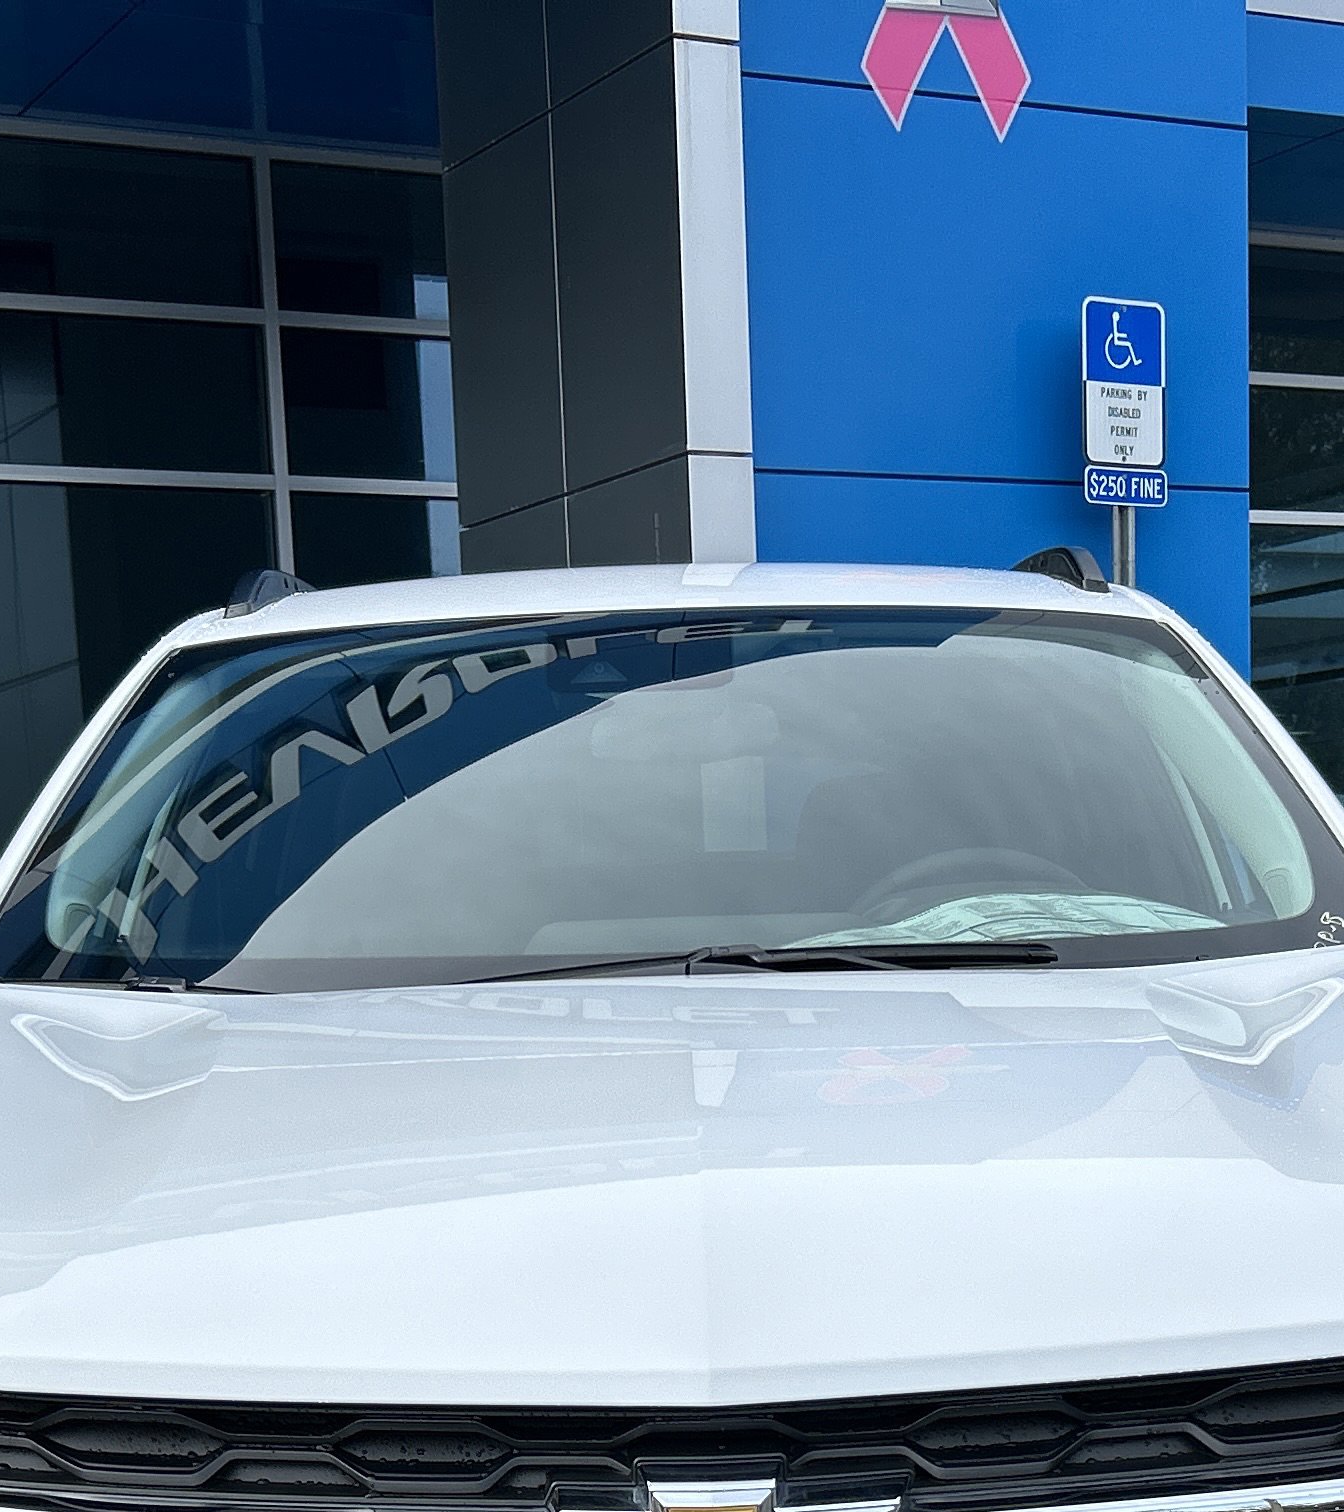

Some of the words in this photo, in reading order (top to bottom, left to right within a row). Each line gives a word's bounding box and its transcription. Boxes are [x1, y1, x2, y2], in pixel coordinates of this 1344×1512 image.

[1100, 386, 1132, 400] PARKING
[1137, 389, 1148, 401] BY
[1107, 405, 1141, 419] DISABLED
[1110, 425, 1138, 438] PERMIT
[1114, 444, 1134, 456] ONLY
[1089, 471, 1127, 498] $250
[1131, 476, 1163, 500] FINE
